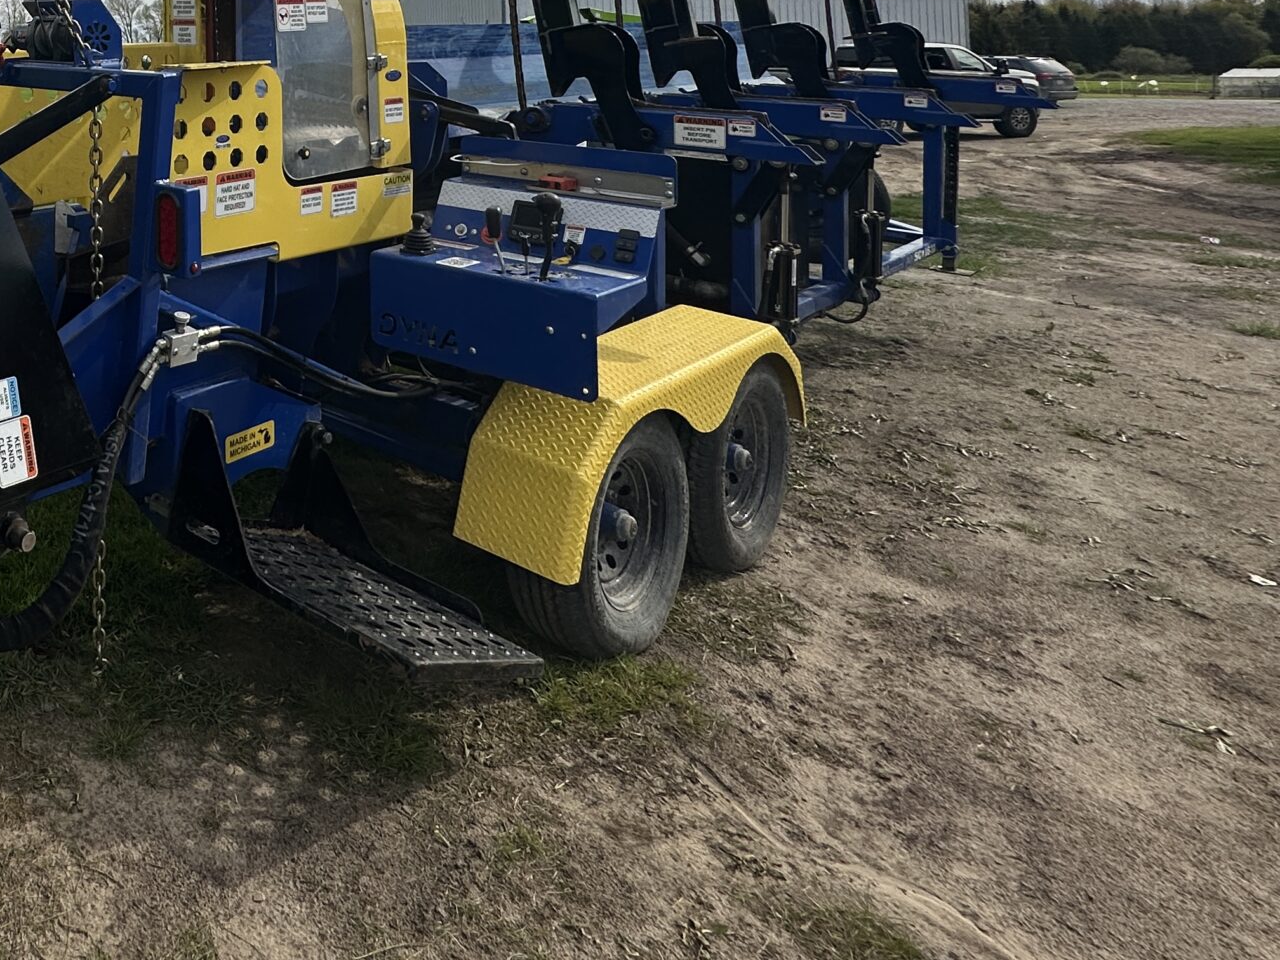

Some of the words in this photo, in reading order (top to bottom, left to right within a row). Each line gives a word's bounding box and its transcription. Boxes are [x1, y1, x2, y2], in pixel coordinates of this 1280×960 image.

[682, 136, 717, 144] TRANSPORT
[226, 171, 253, 181] WARNING
[383, 175, 411, 186] CAUTION
[217, 195, 227, 203] FACE
[228, 191, 253, 201] PROTECTION
[221, 185, 233, 193] HARD
[9, 380, 19, 413] NOTICE!
[229, 434, 248, 447] MADE
[249, 431, 256, 441] IN
[6, 435, 16, 470] HANDS
[14, 435, 23, 461] KEEP
[23, 431, 35, 473] WARNING
[229, 440, 261, 458] MICHIGAN
